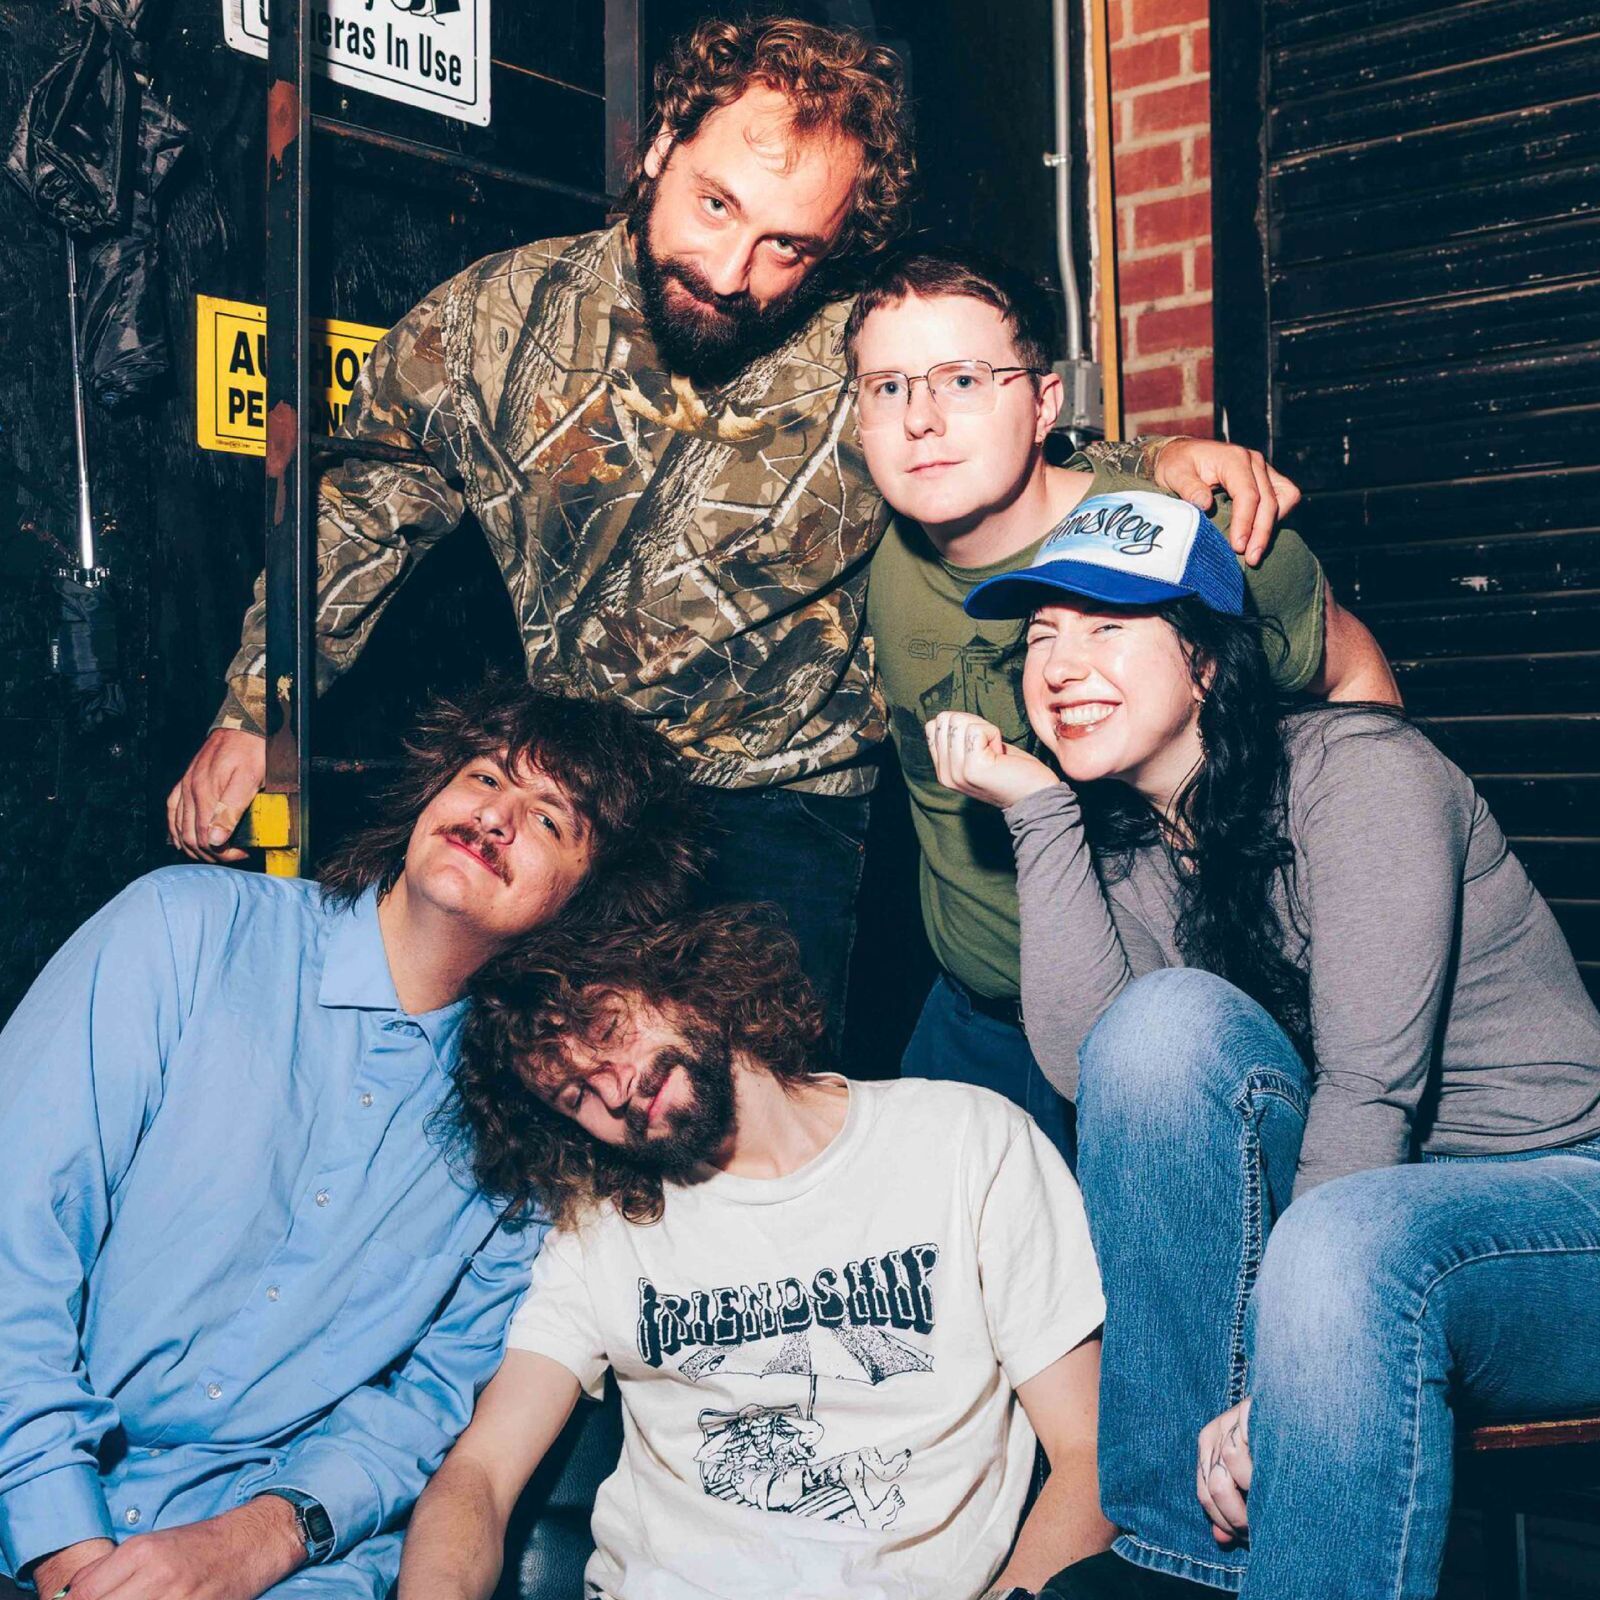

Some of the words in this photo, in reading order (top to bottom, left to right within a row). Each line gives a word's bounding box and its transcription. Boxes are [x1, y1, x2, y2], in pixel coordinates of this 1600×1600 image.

[260, 0, 376, 60] eras
[387, 22, 409, 71] In
[419, 33, 462, 87] Use
[637, 1243, 940, 1368] FRIENDSHIP
